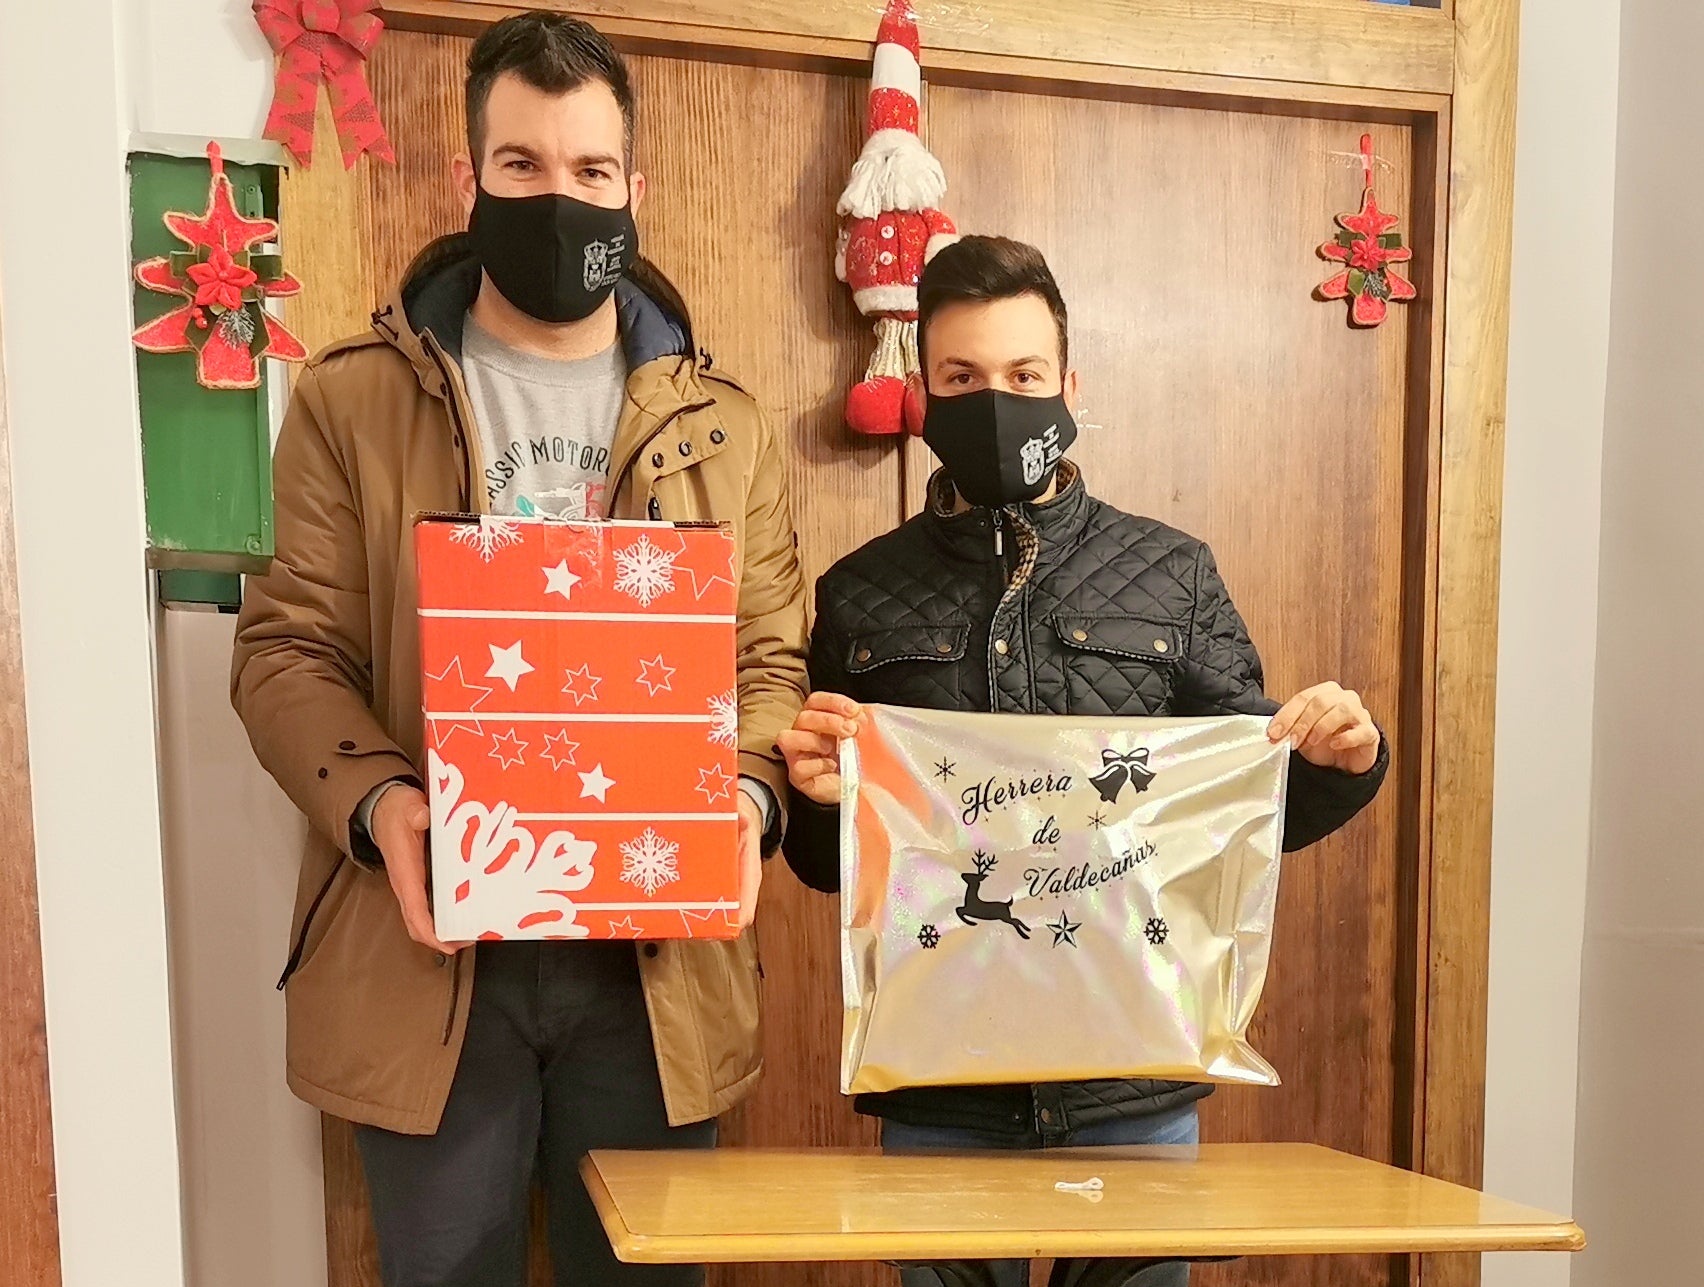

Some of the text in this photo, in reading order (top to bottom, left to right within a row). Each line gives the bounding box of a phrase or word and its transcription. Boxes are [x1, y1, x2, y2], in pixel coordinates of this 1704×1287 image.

[484, 436, 609, 507] ASSIC MOTOR
[962, 773, 1072, 825] Herrera
[1032, 815, 1060, 845] de
[1023, 839, 1156, 897] Valdecañas
